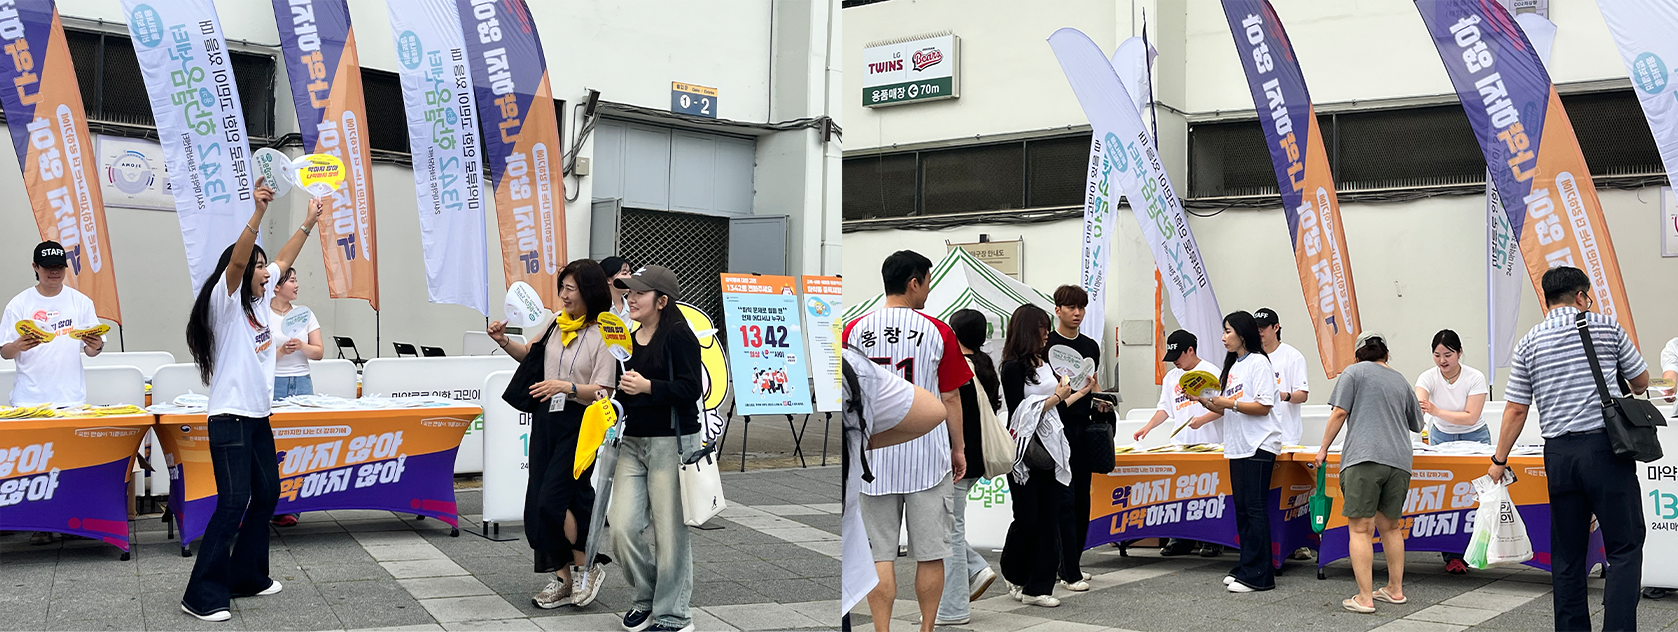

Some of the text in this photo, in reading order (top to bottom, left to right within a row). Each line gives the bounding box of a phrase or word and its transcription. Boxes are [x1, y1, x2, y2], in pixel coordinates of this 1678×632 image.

[914, 50, 943, 65] Bears
[868, 59, 903, 74] TWINS
[872, 87, 905, 102] 용품매장
[920, 84, 940, 94] 70m
[701, 97, 709, 114] 2
[41, 248, 64, 257] STAFF
[453, 389, 480, 400] 고민이
[323, 427, 347, 435] 강하기에
[345, 431, 403, 465] 않아
[355, 457, 406, 499] 않아
[1111, 472, 1220, 508] 약하지 않아
[1403, 484, 1447, 513] 하지
[1110, 496, 1226, 535] 나약하지 않아
[1652, 522, 1669, 531] 24시
